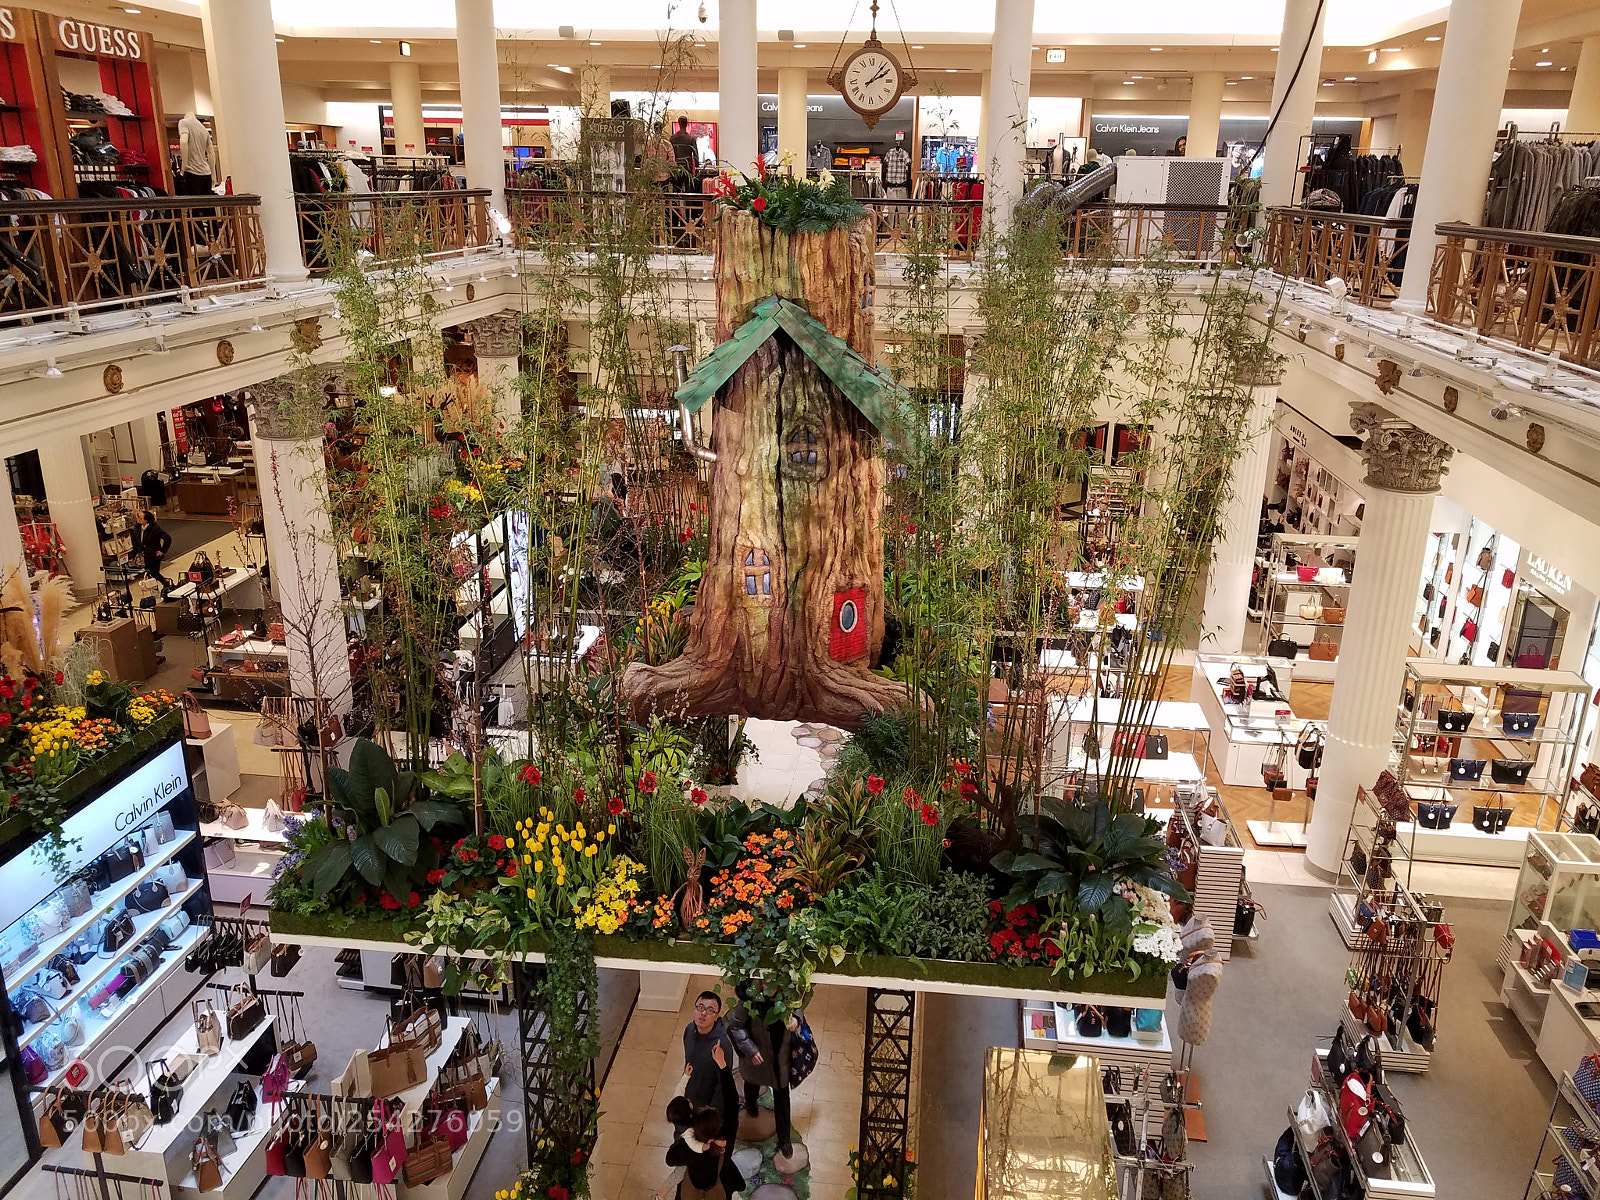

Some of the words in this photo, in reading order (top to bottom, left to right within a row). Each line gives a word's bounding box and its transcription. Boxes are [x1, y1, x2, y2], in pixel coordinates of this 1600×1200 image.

[58, 20, 141, 59] GUESS
[761, 102, 778, 111] Calv
[1095, 123, 1119, 133] Calvin
[1119, 123, 1137, 133] Klein
[1137, 124, 1160, 134] Jeans
[114, 795, 154, 832] Calvin
[153, 774, 182, 804] Klein
